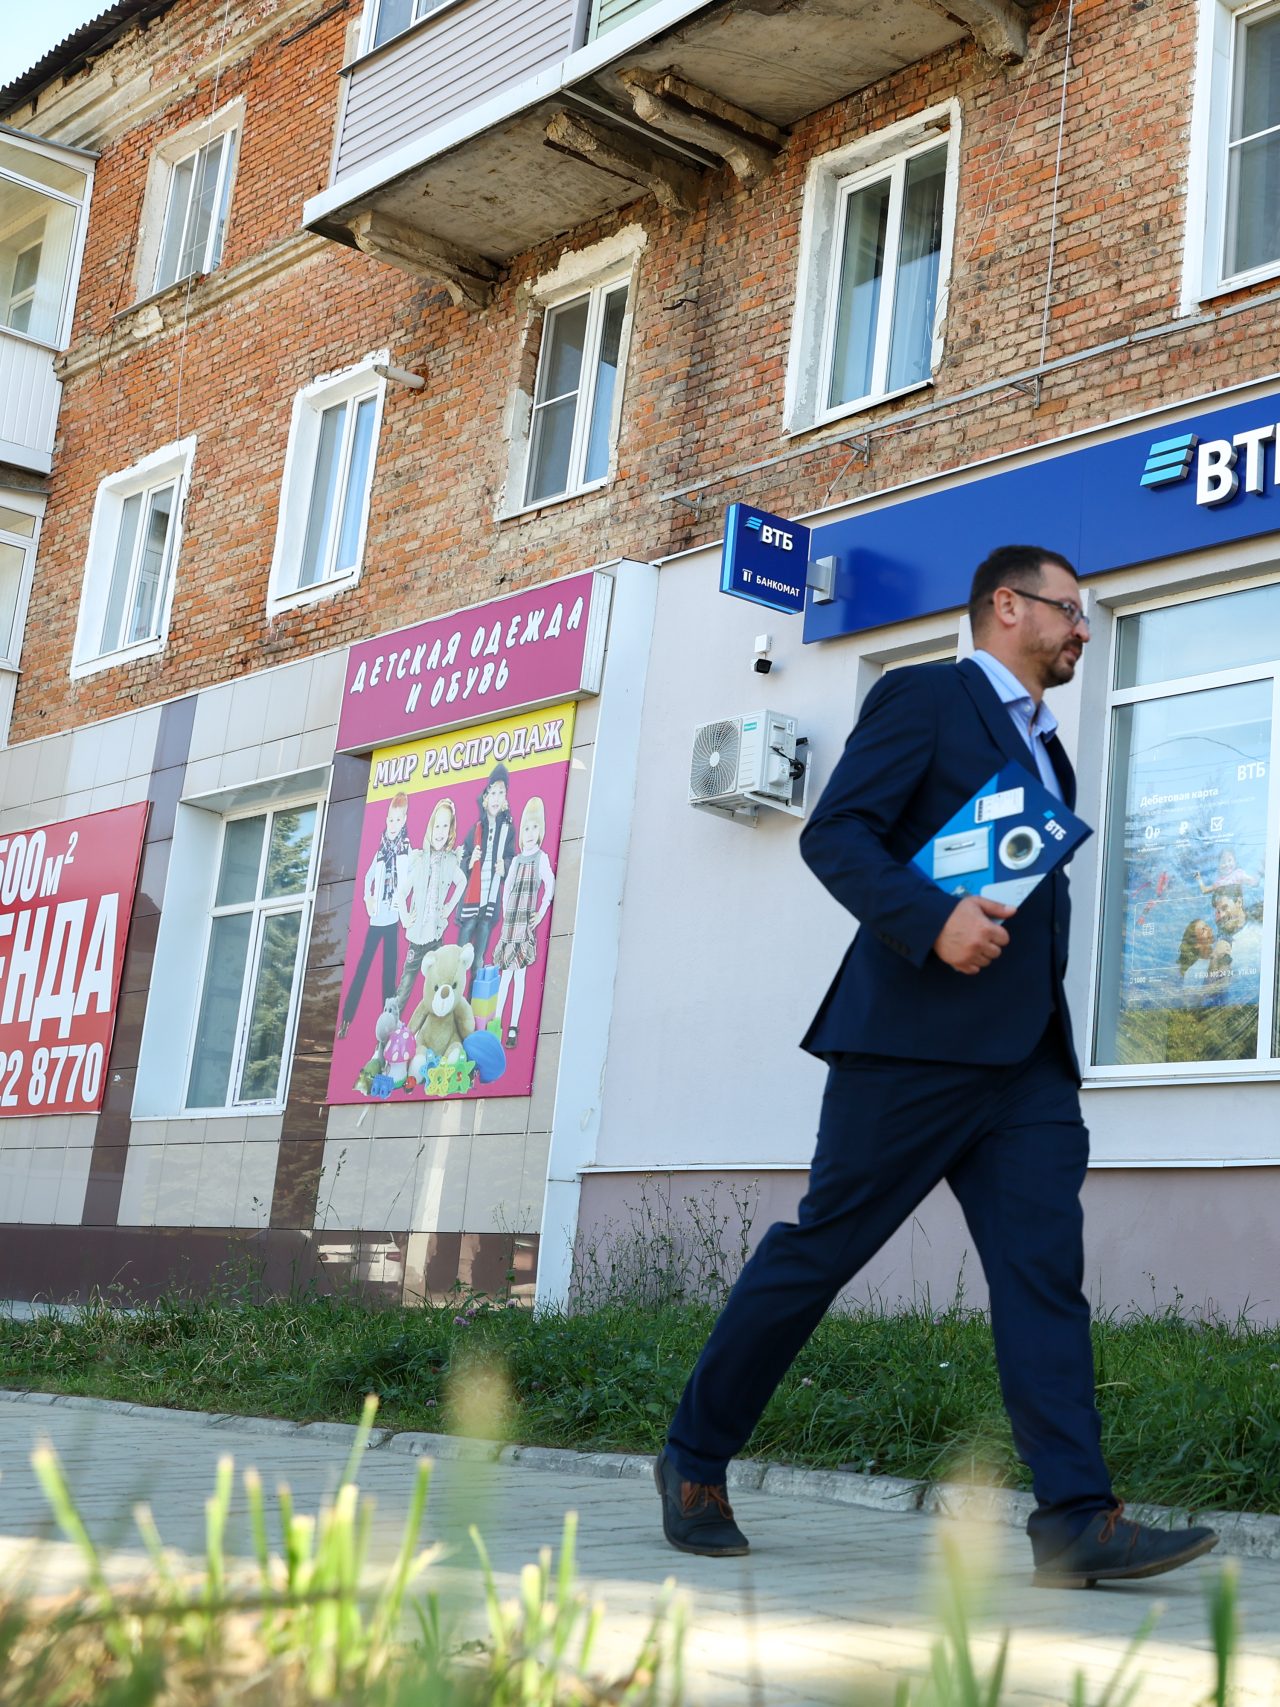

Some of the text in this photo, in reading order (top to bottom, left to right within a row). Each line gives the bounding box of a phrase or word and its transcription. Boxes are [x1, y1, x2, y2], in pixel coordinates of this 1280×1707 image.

[762, 524, 794, 551] ВТБ
[756, 575, 800, 598] БАНКОМАТ
[350, 596, 584, 695] ДЕТСКАЯ ОДЕЖДА
[405, 658, 510, 714] И ОБУВЬ
[373, 719, 564, 789] МИР РАСПРОДАЖ
[1237, 761, 1266, 782] ВТБ
[1044, 819, 1068, 842] ВТБ
[0, 1042, 104, 1107] 2 8770
